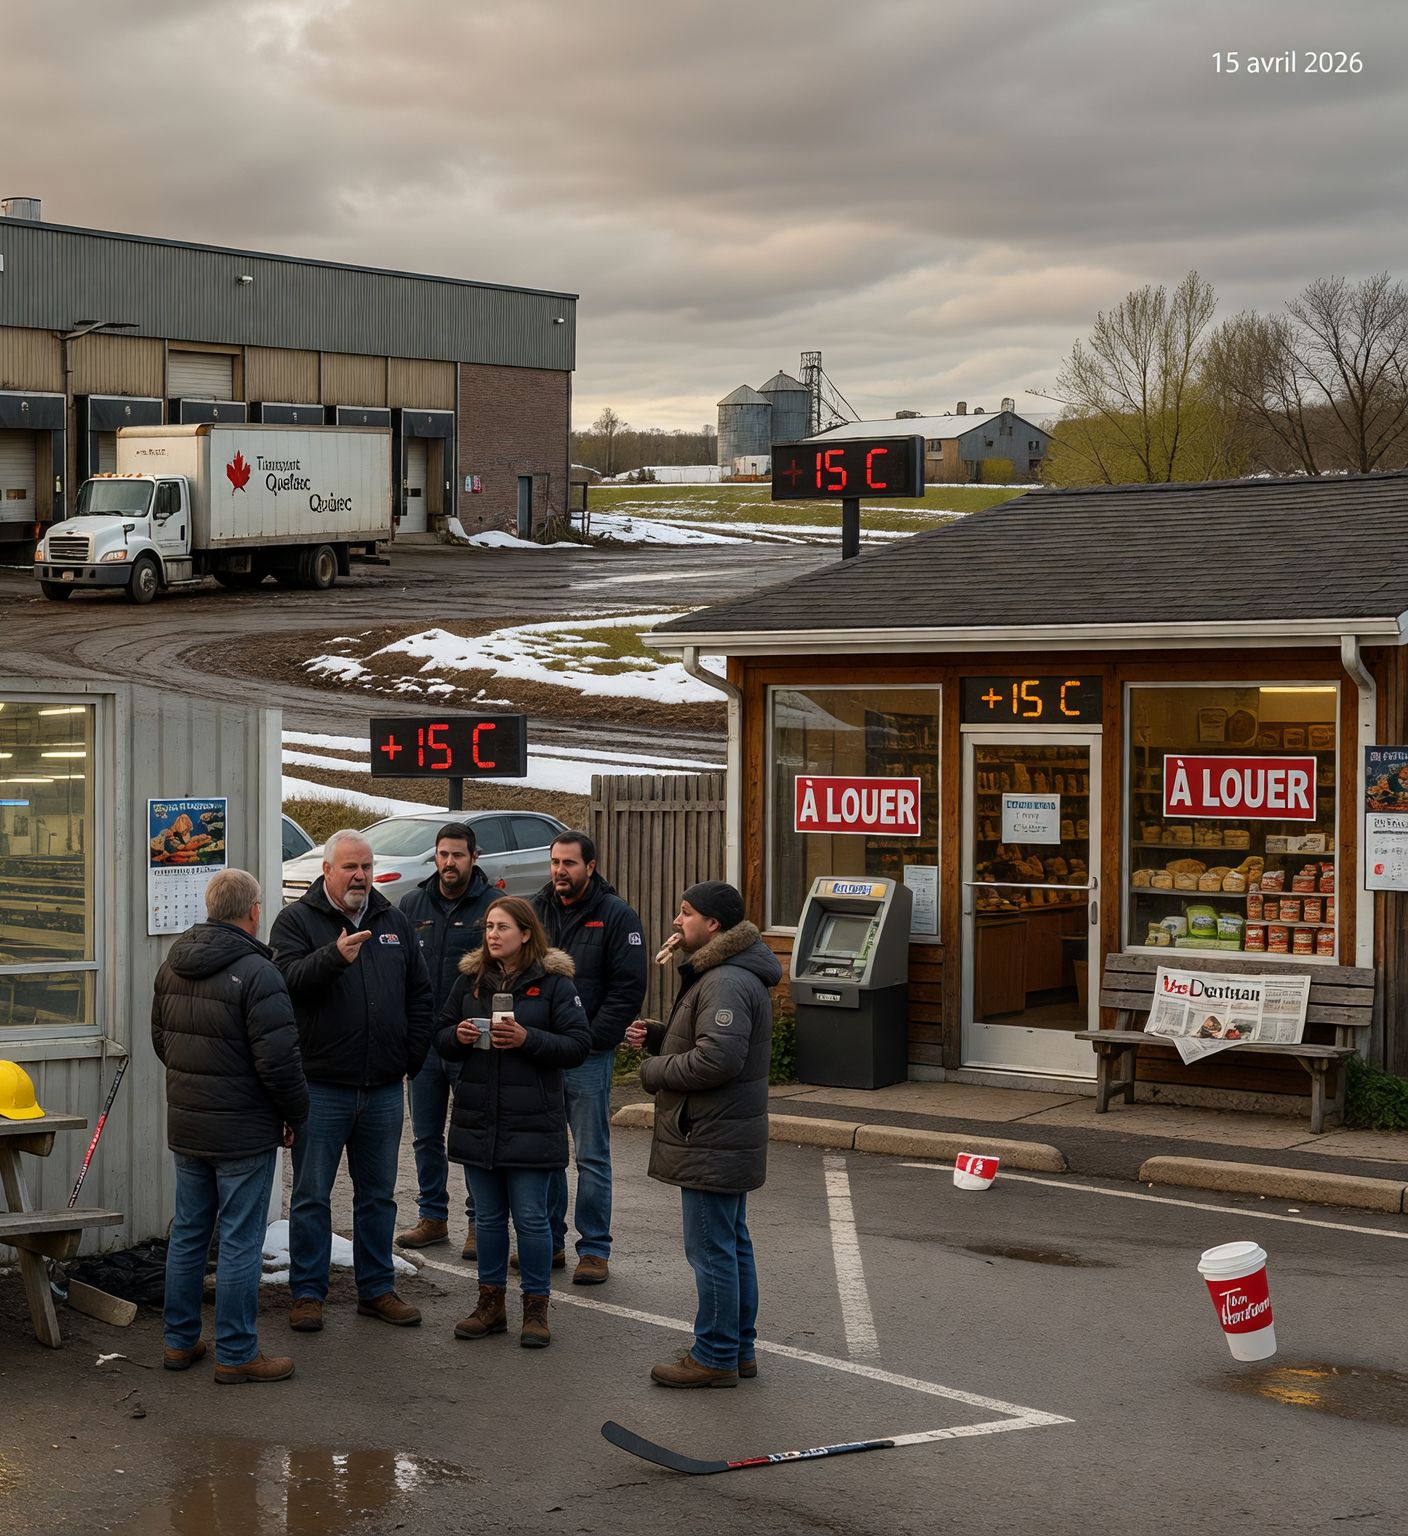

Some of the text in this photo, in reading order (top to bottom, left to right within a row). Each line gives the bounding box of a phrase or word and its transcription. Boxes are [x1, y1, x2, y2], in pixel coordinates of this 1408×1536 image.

[866, 448, 888, 488] C
[981, 680, 1081, 717] +15 C
[380, 723, 496, 769] +15 C
[800, 780, 916, 825] À LOUER
[1169, 759, 1310, 809] À LOUER
